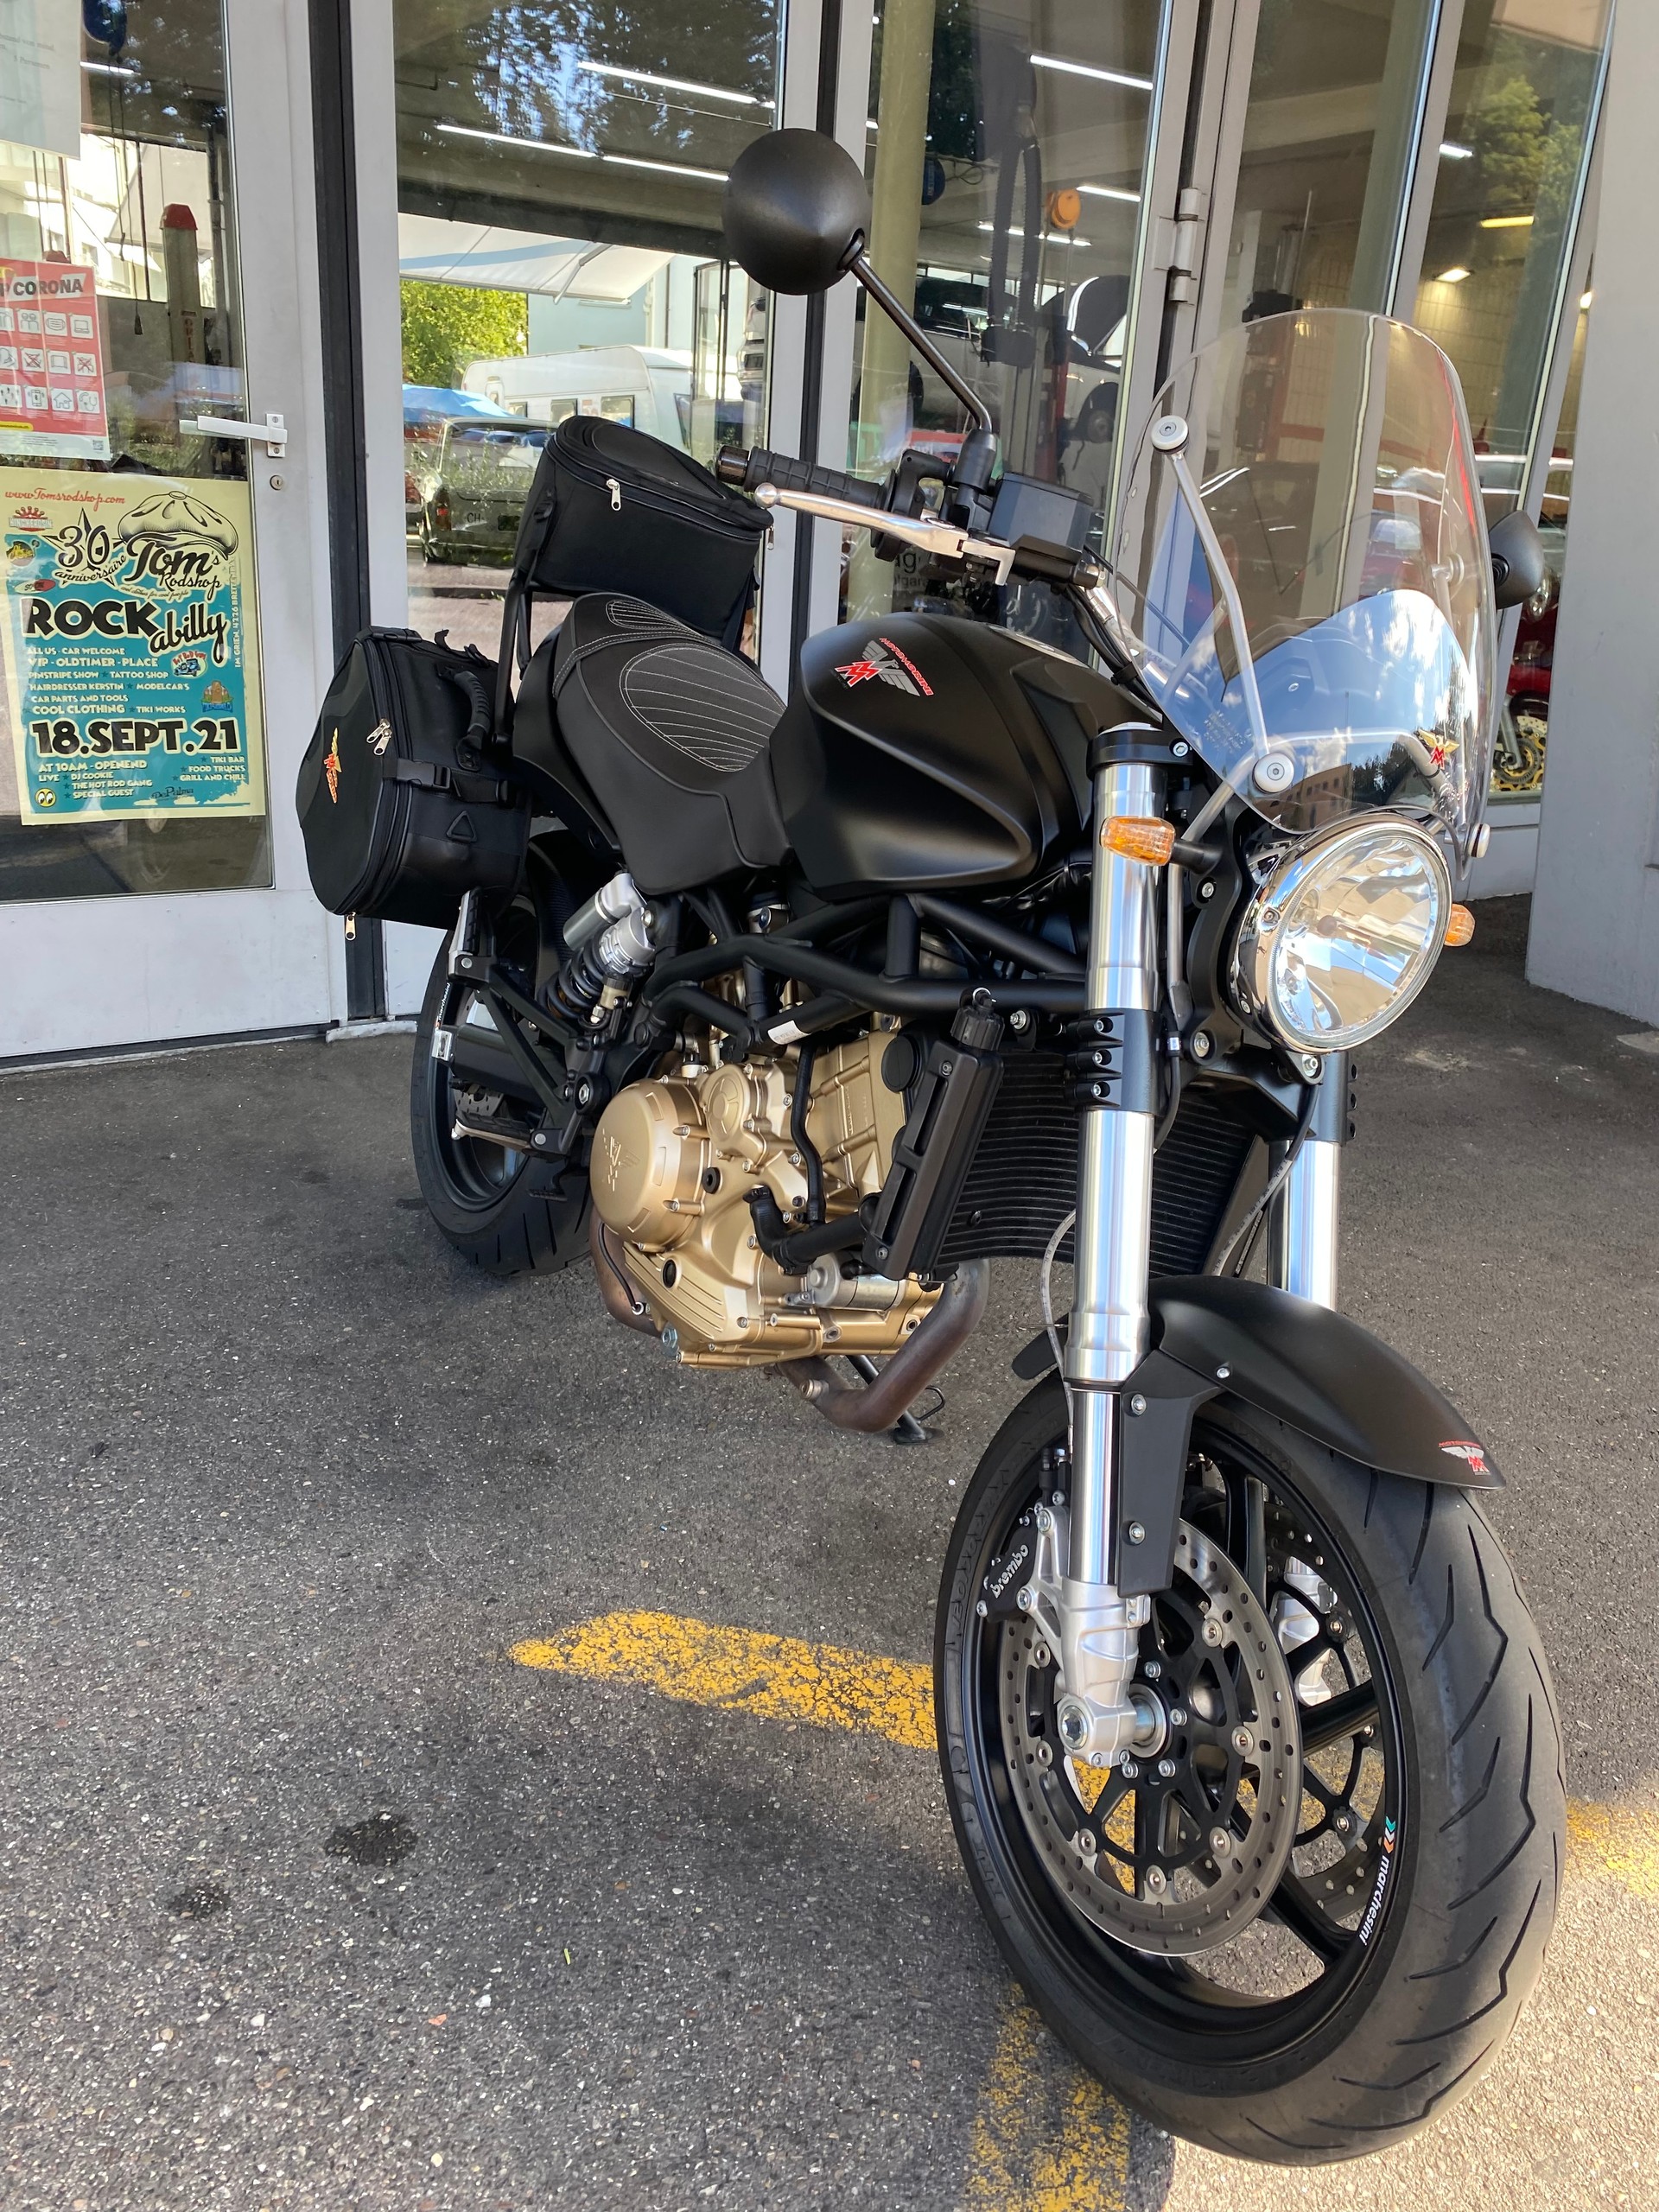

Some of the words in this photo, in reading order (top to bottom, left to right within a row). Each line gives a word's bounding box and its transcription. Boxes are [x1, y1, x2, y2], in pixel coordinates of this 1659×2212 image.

[13, 278, 84, 296] CORONA
[58, 524, 110, 569] 30
[124, 533, 220, 582] Tom's
[54, 555, 127, 582] anniversaire
[159, 570, 222, 601] Rodshop
[27, 598, 159, 638] ROCK
[231, 607, 240, 629] 4226
[149, 603, 227, 664] abilly
[28, 658, 49, 667] VIP
[55, 658, 116, 667] OLDTIMER
[109, 671, 144, 679] TATTOO
[145, 671, 169, 679] SHOP
[29, 683, 88, 691] HAIRDRESSER
[136, 683, 190, 691] MODELCAR'S
[51, 695, 79, 703] PARTS
[100, 694, 129, 702] TOOLS
[32, 705, 66, 715] COOL
[67, 704, 125, 715] CLOTHING
[136, 705, 153, 714] TIKI
[32, 719, 238, 755] 18.SEPT.21
[38, 763, 54, 773] AT
[55, 761, 88, 772] 10AM
[213, 764, 246, 773] TRUCKS
[38, 773, 60, 782] LIVE
[70, 772, 81, 781] DJ
[82, 771, 114, 780] COOKIE
[72, 781, 89, 790] THE
[89, 780, 106, 789] HOT
[107, 779, 126, 788] ROD
[127, 779, 153, 788] GANG
[73, 790, 107, 799] SPECIAL
[107, 788, 135, 798] GUEST
[989, 1543, 1029, 1599] brembo
[1359, 1855, 1390, 1946] marchesini
